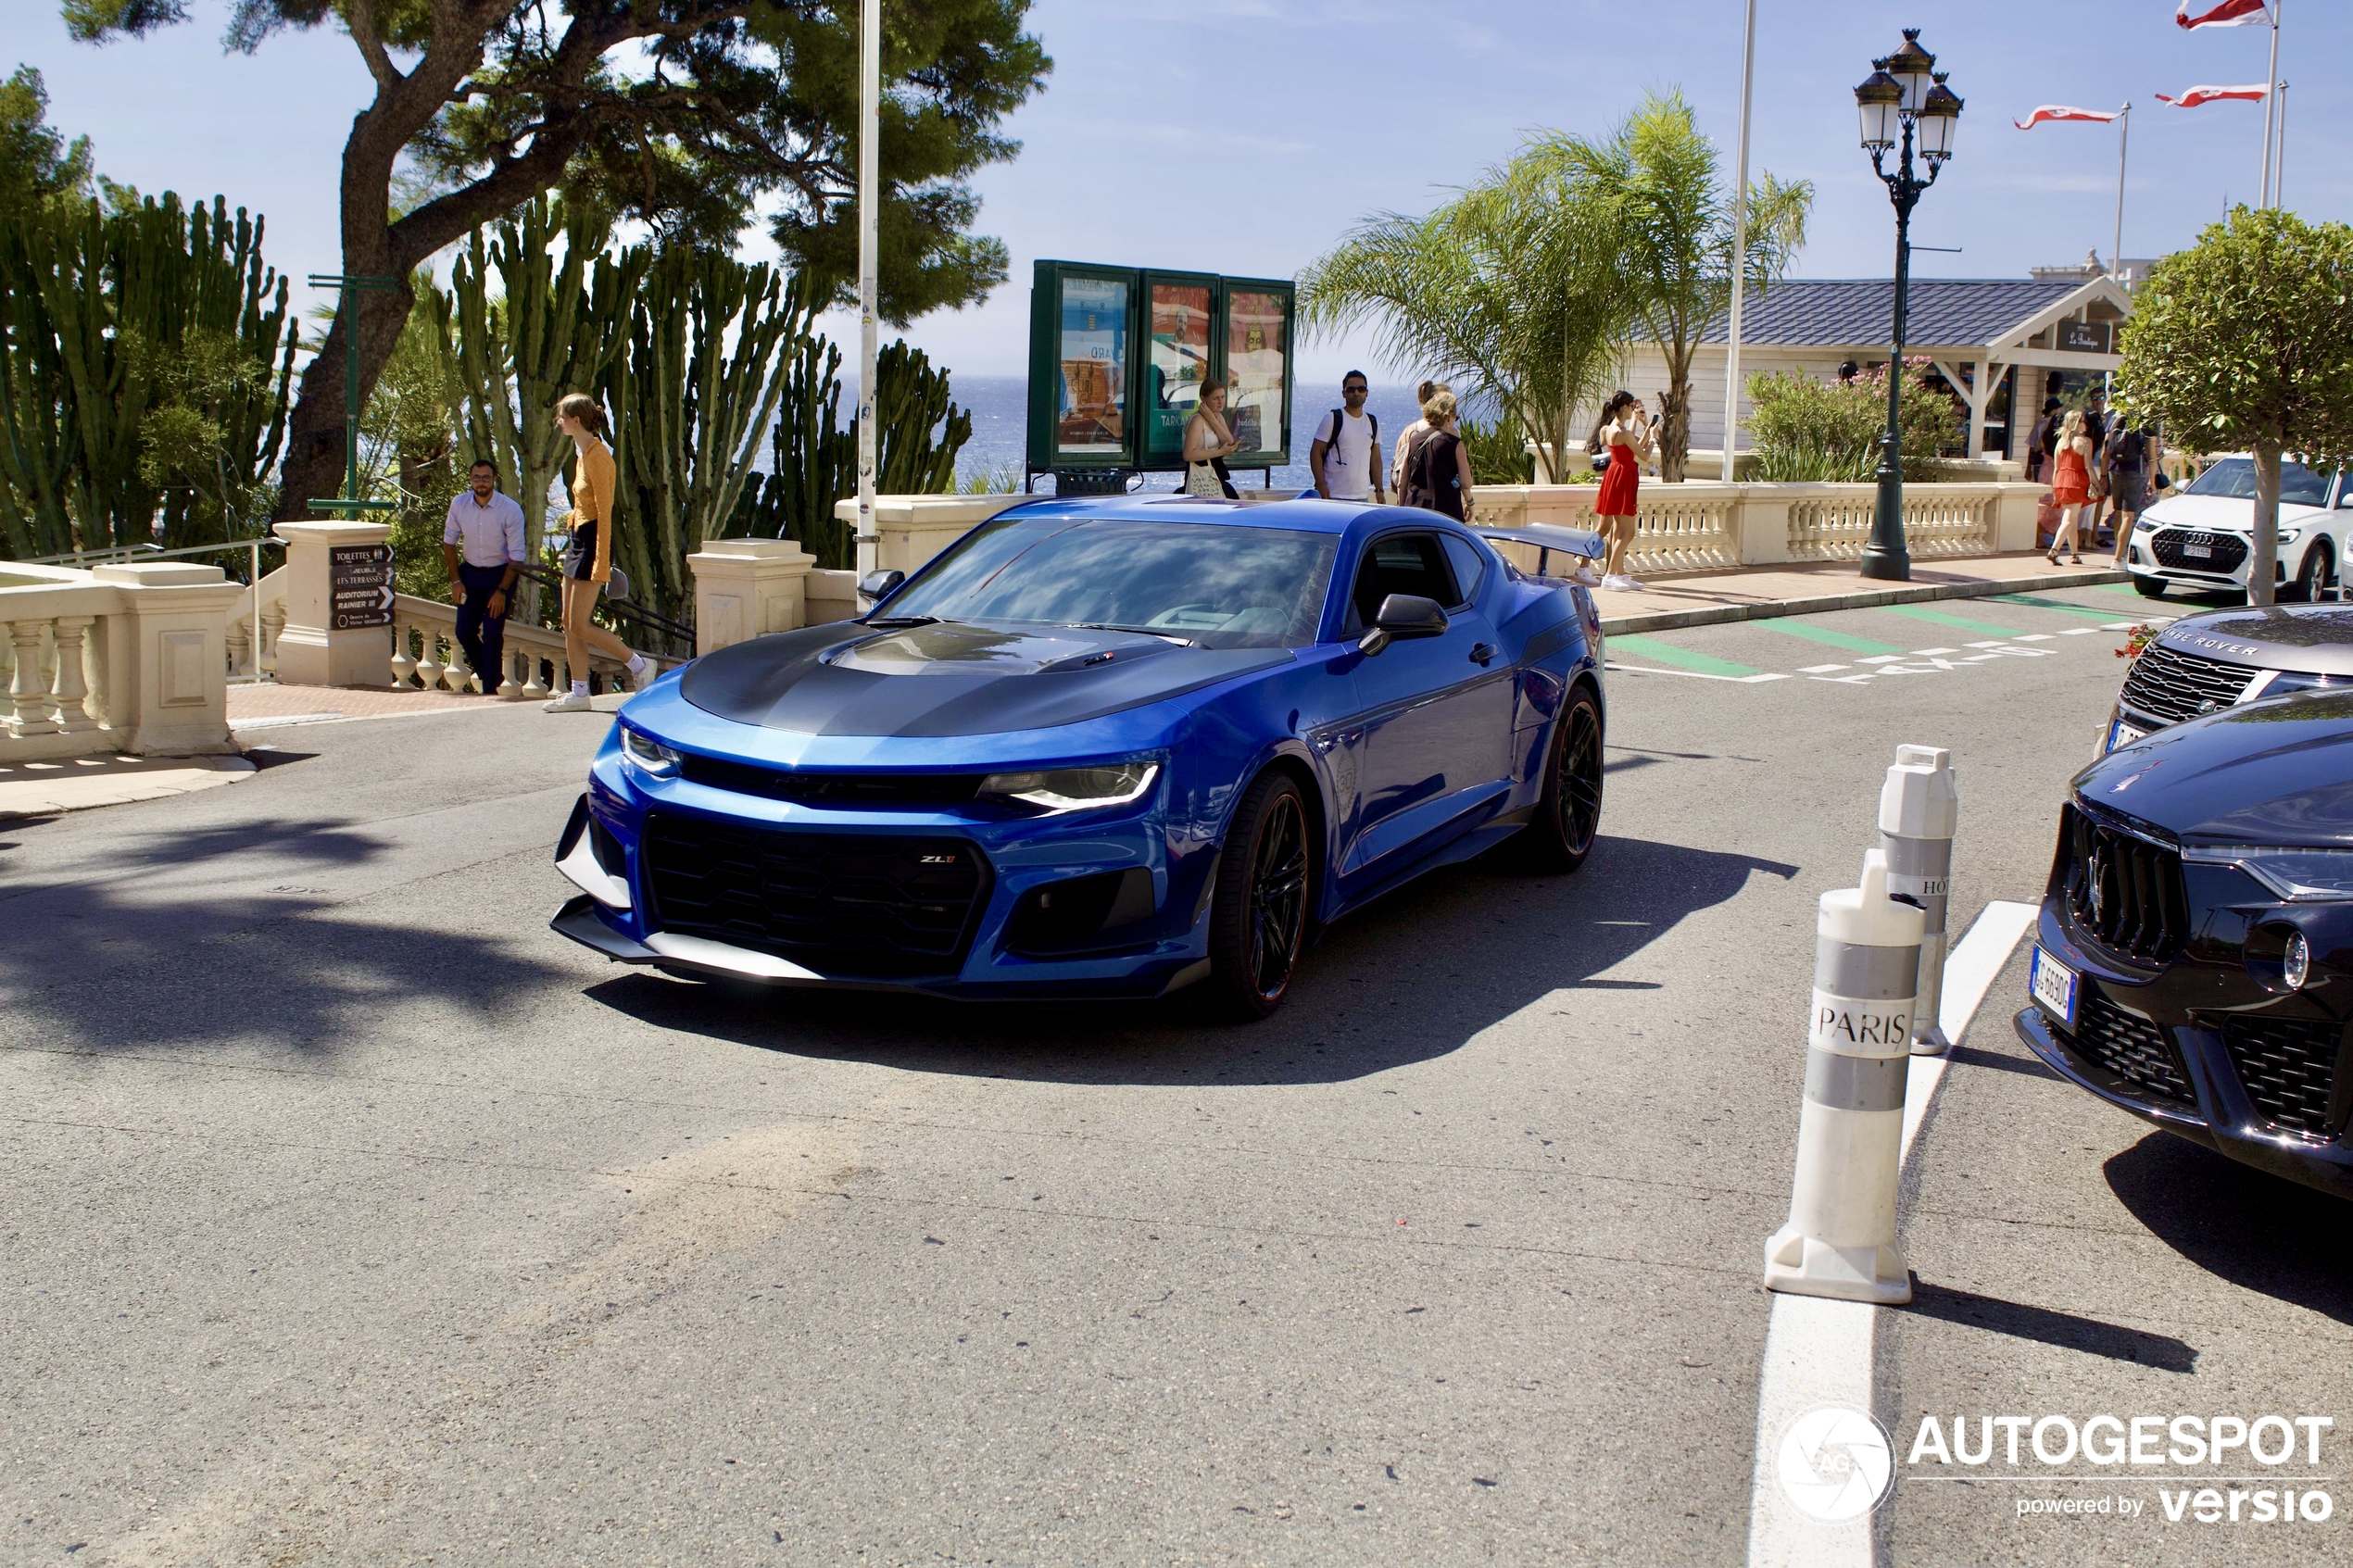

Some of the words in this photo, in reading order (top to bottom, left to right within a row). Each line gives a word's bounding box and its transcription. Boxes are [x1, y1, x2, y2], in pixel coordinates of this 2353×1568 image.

[336, 552, 371, 561] TOILETTES
[350, 576, 384, 584] TERRASSES
[335, 590, 379, 600] AUDITORIUM
[337, 601, 367, 609] RAINIER
[368, 599, 376, 608] III
[2194, 636, 2259, 656] ROVER
[1806, 646, 2058, 685] TAXIS
[920, 855, 956, 863] ZL1
[1819, 1007, 1906, 1045] PARIS
